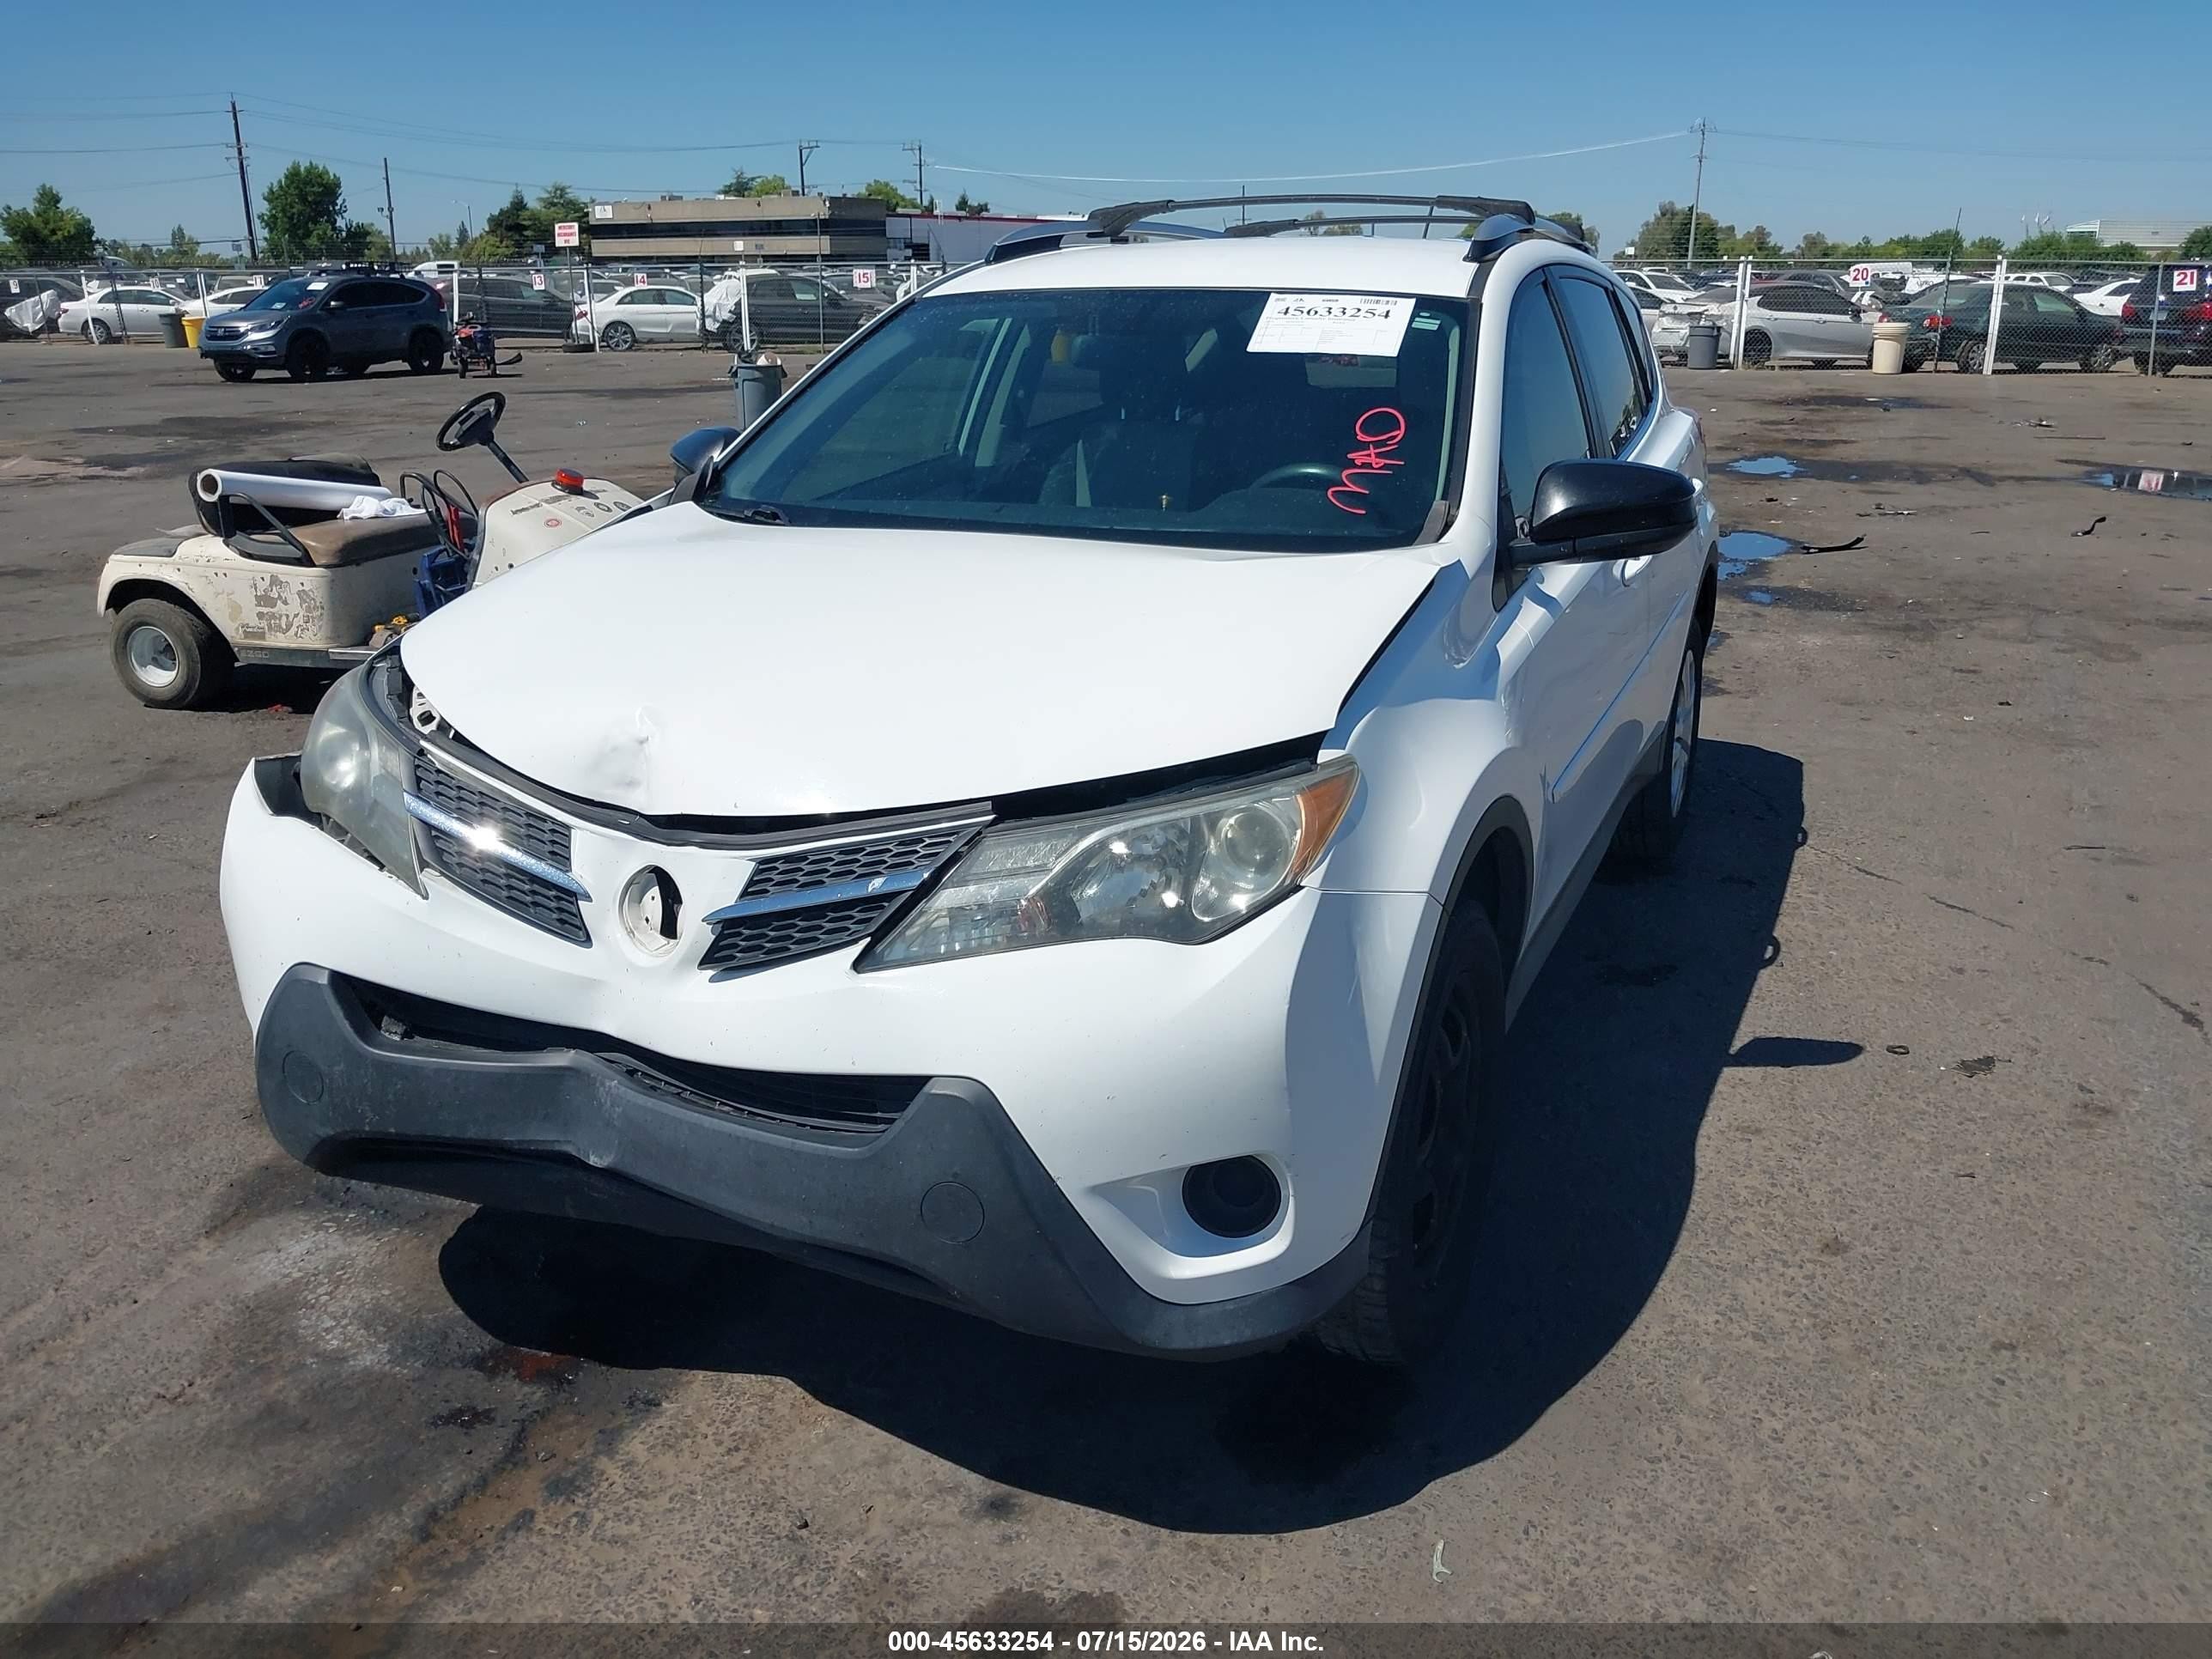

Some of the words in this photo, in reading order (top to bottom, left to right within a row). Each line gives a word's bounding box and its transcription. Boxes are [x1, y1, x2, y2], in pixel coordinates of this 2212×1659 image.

[533, 276, 543, 285] 13
[635, 275, 646, 284] 14
[859, 272, 869, 283] 15
[1852, 268, 1869, 281] 20
[2176, 271, 2195, 285] 21
[1277, 306, 1391, 319] 45633254
